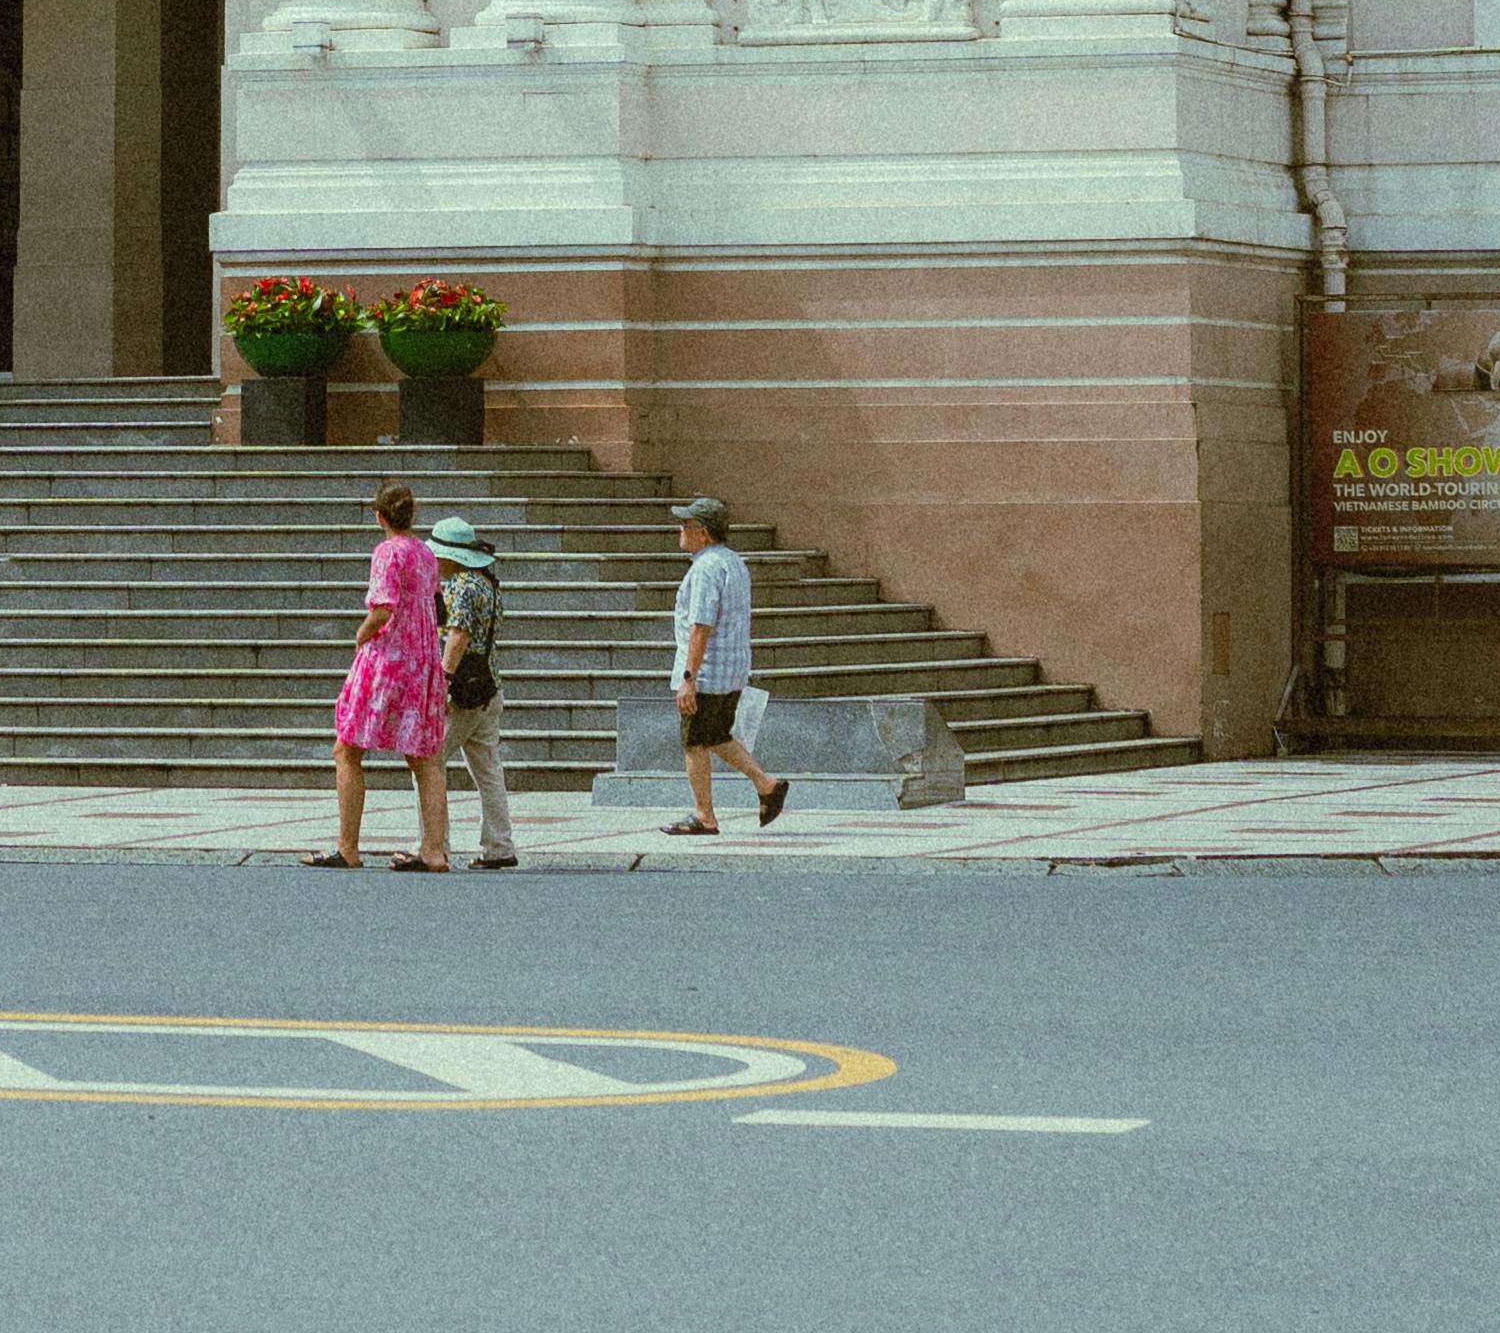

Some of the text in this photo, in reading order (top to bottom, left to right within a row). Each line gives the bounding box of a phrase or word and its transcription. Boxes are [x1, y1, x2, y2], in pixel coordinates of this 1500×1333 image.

[1333, 430, 1388, 444] ENJOY
[1333, 447, 1364, 479] A
[1367, 447, 1399, 479] O
[1334, 483, 1365, 498] THE
[1334, 500, 1409, 513] VIETNAMESE
[1411, 499, 1467, 512] BAMBOO
